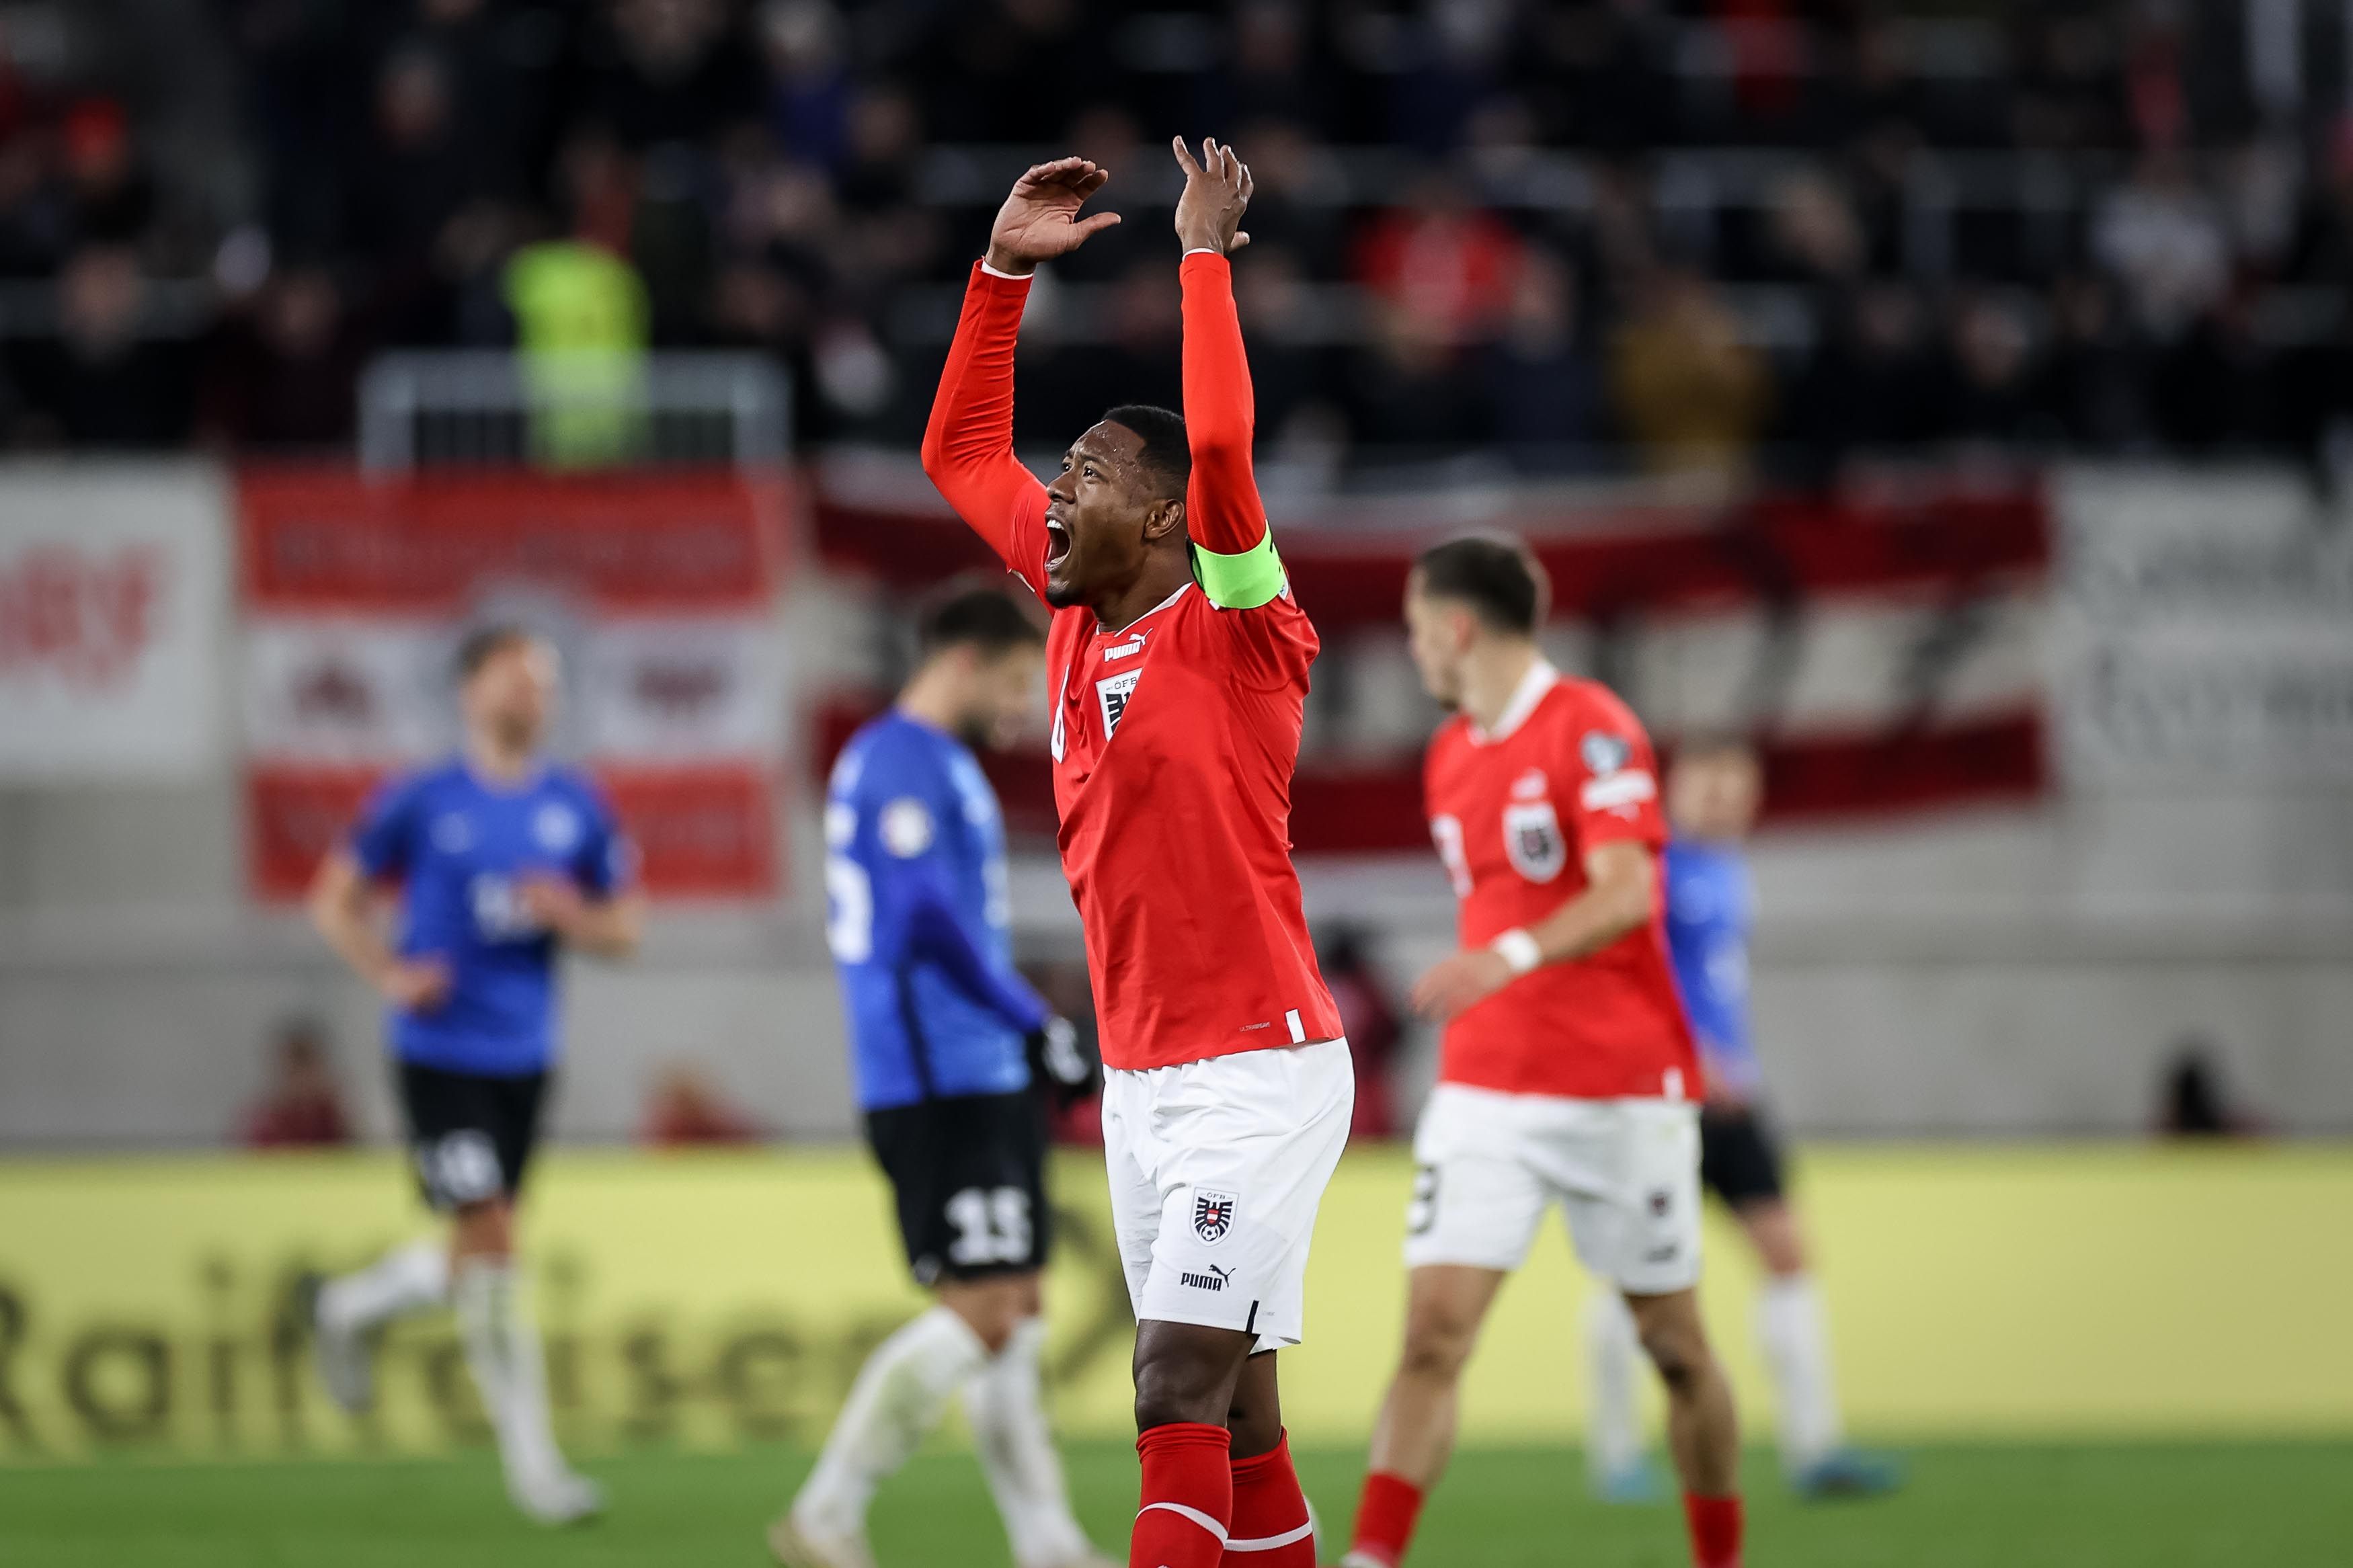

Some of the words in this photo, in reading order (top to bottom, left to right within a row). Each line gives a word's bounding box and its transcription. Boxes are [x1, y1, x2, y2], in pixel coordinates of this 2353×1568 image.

[1104, 640, 1142, 663] PUMA
[1114, 676, 1138, 690] ÖFB
[944, 1186, 1034, 1266] 15
[1181, 1272, 1223, 1291] PUMA
[0, 1243, 941, 1446] aifeise
